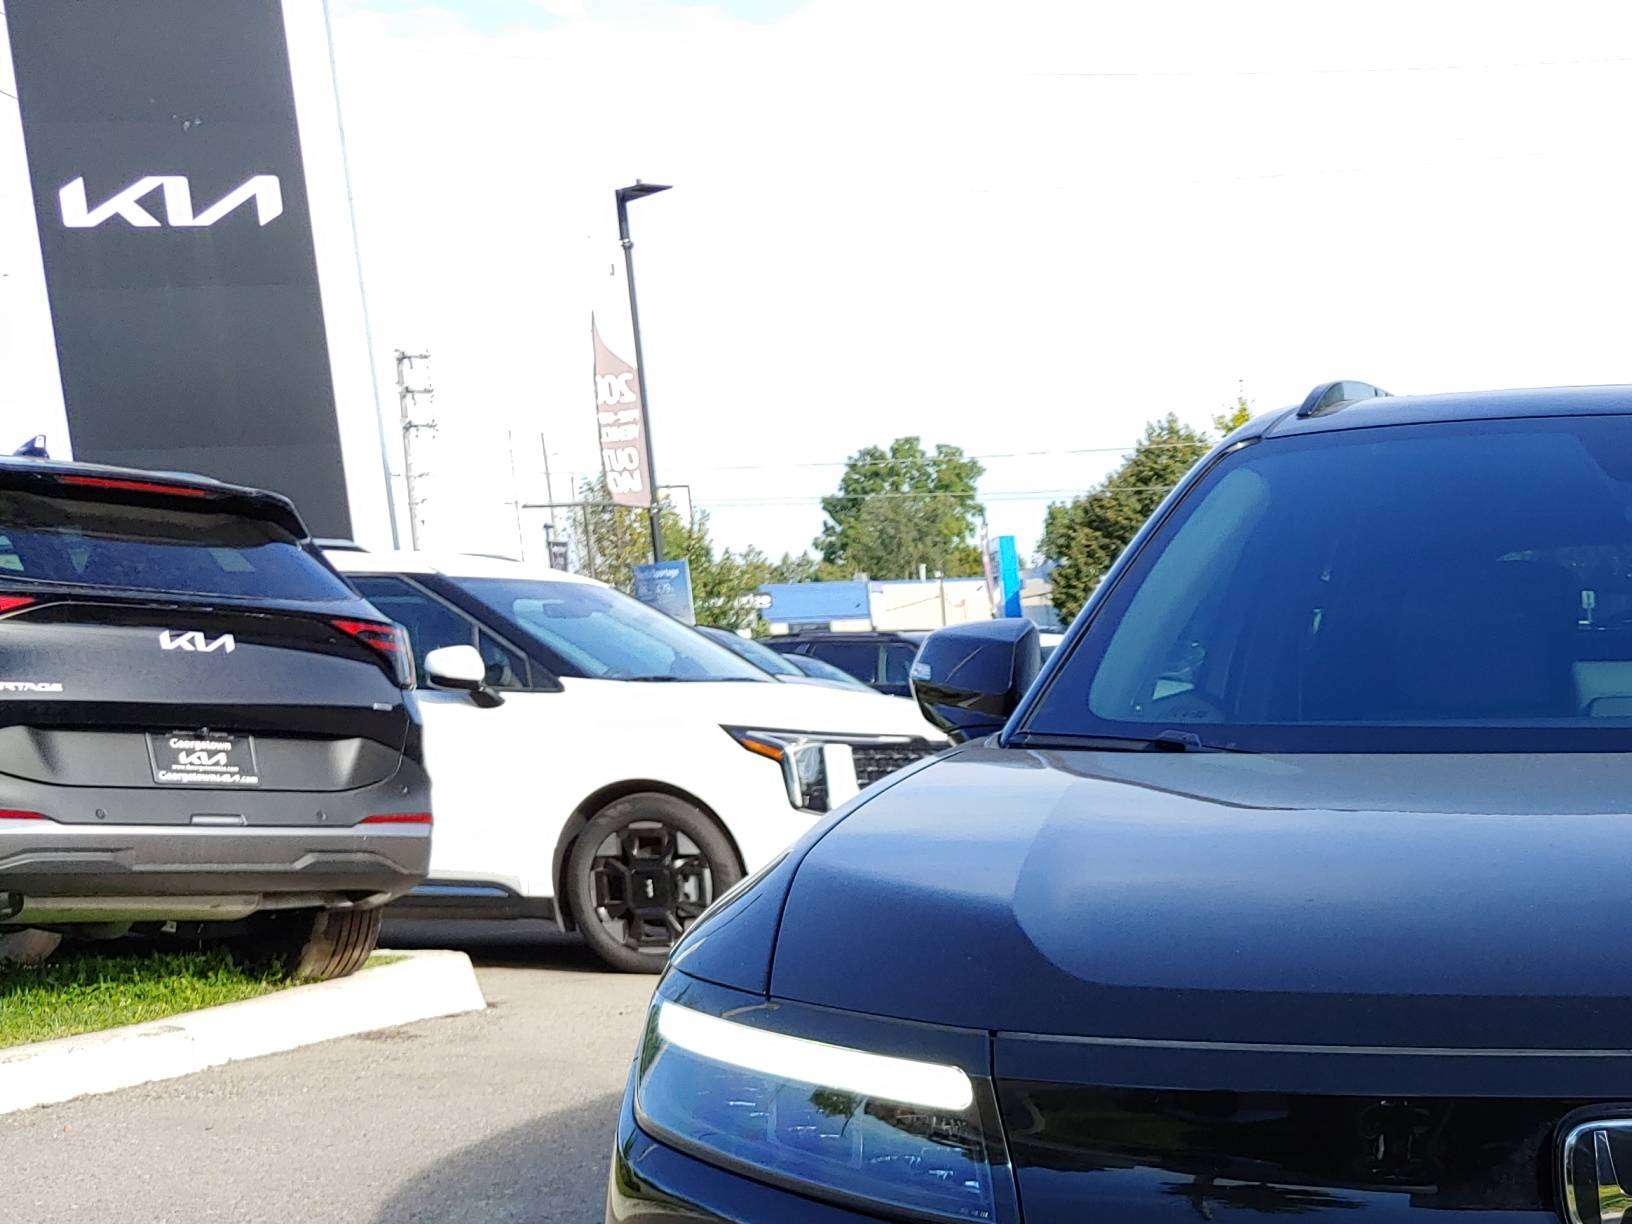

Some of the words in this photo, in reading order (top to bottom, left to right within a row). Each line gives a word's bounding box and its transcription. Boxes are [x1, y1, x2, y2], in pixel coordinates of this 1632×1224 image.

[58, 174, 284, 228] KIA
[159, 629, 236, 655] KIA
[169, 738, 232, 751] Georgetown
[178, 751, 227, 766] KIA
